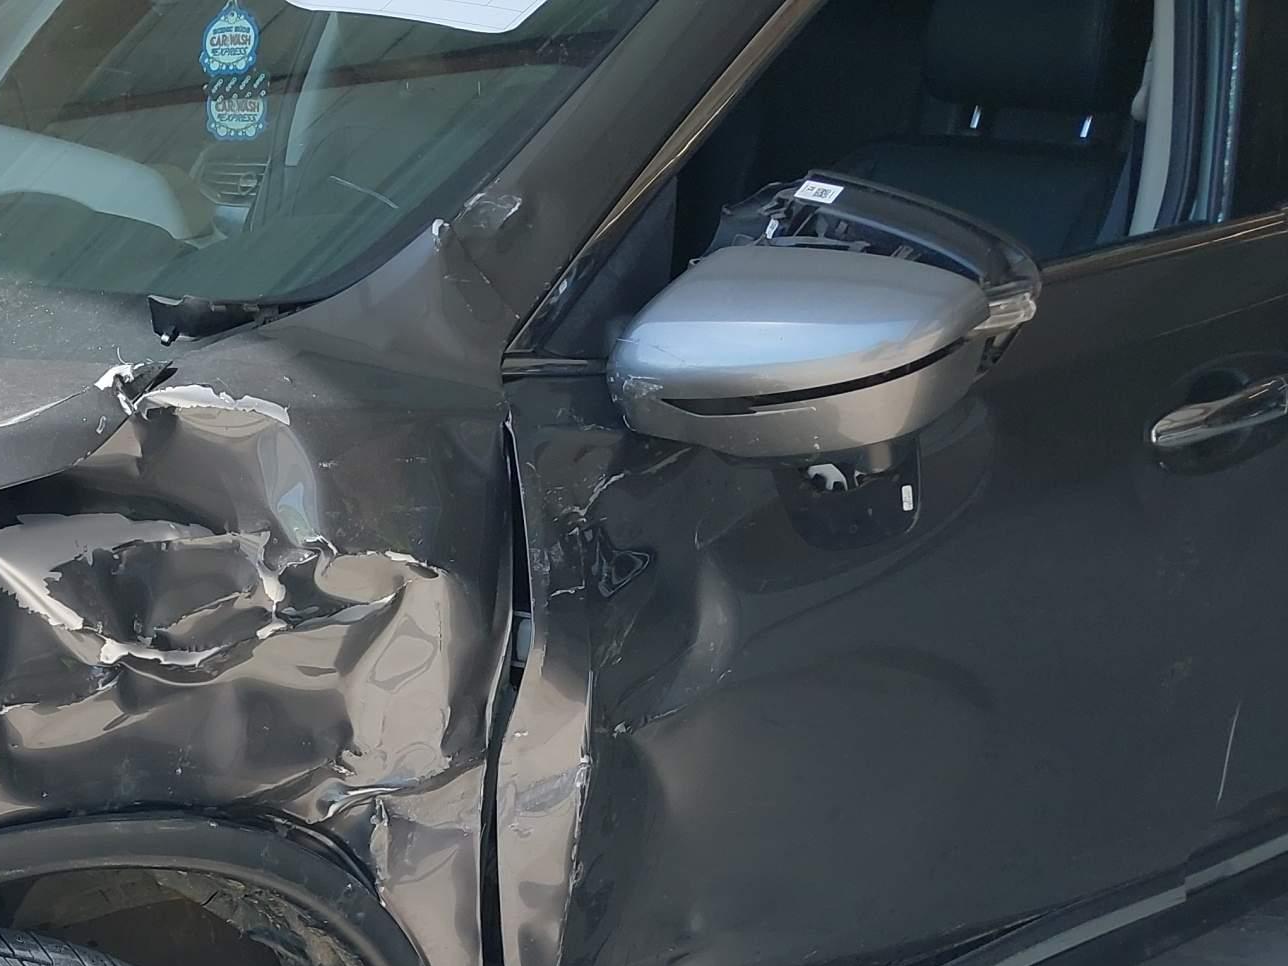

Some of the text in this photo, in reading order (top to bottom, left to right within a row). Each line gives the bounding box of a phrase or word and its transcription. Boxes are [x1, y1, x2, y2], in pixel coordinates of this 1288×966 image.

[210, 33, 251, 47] CAR WASH
[211, 47, 249, 56] EXPRESS
